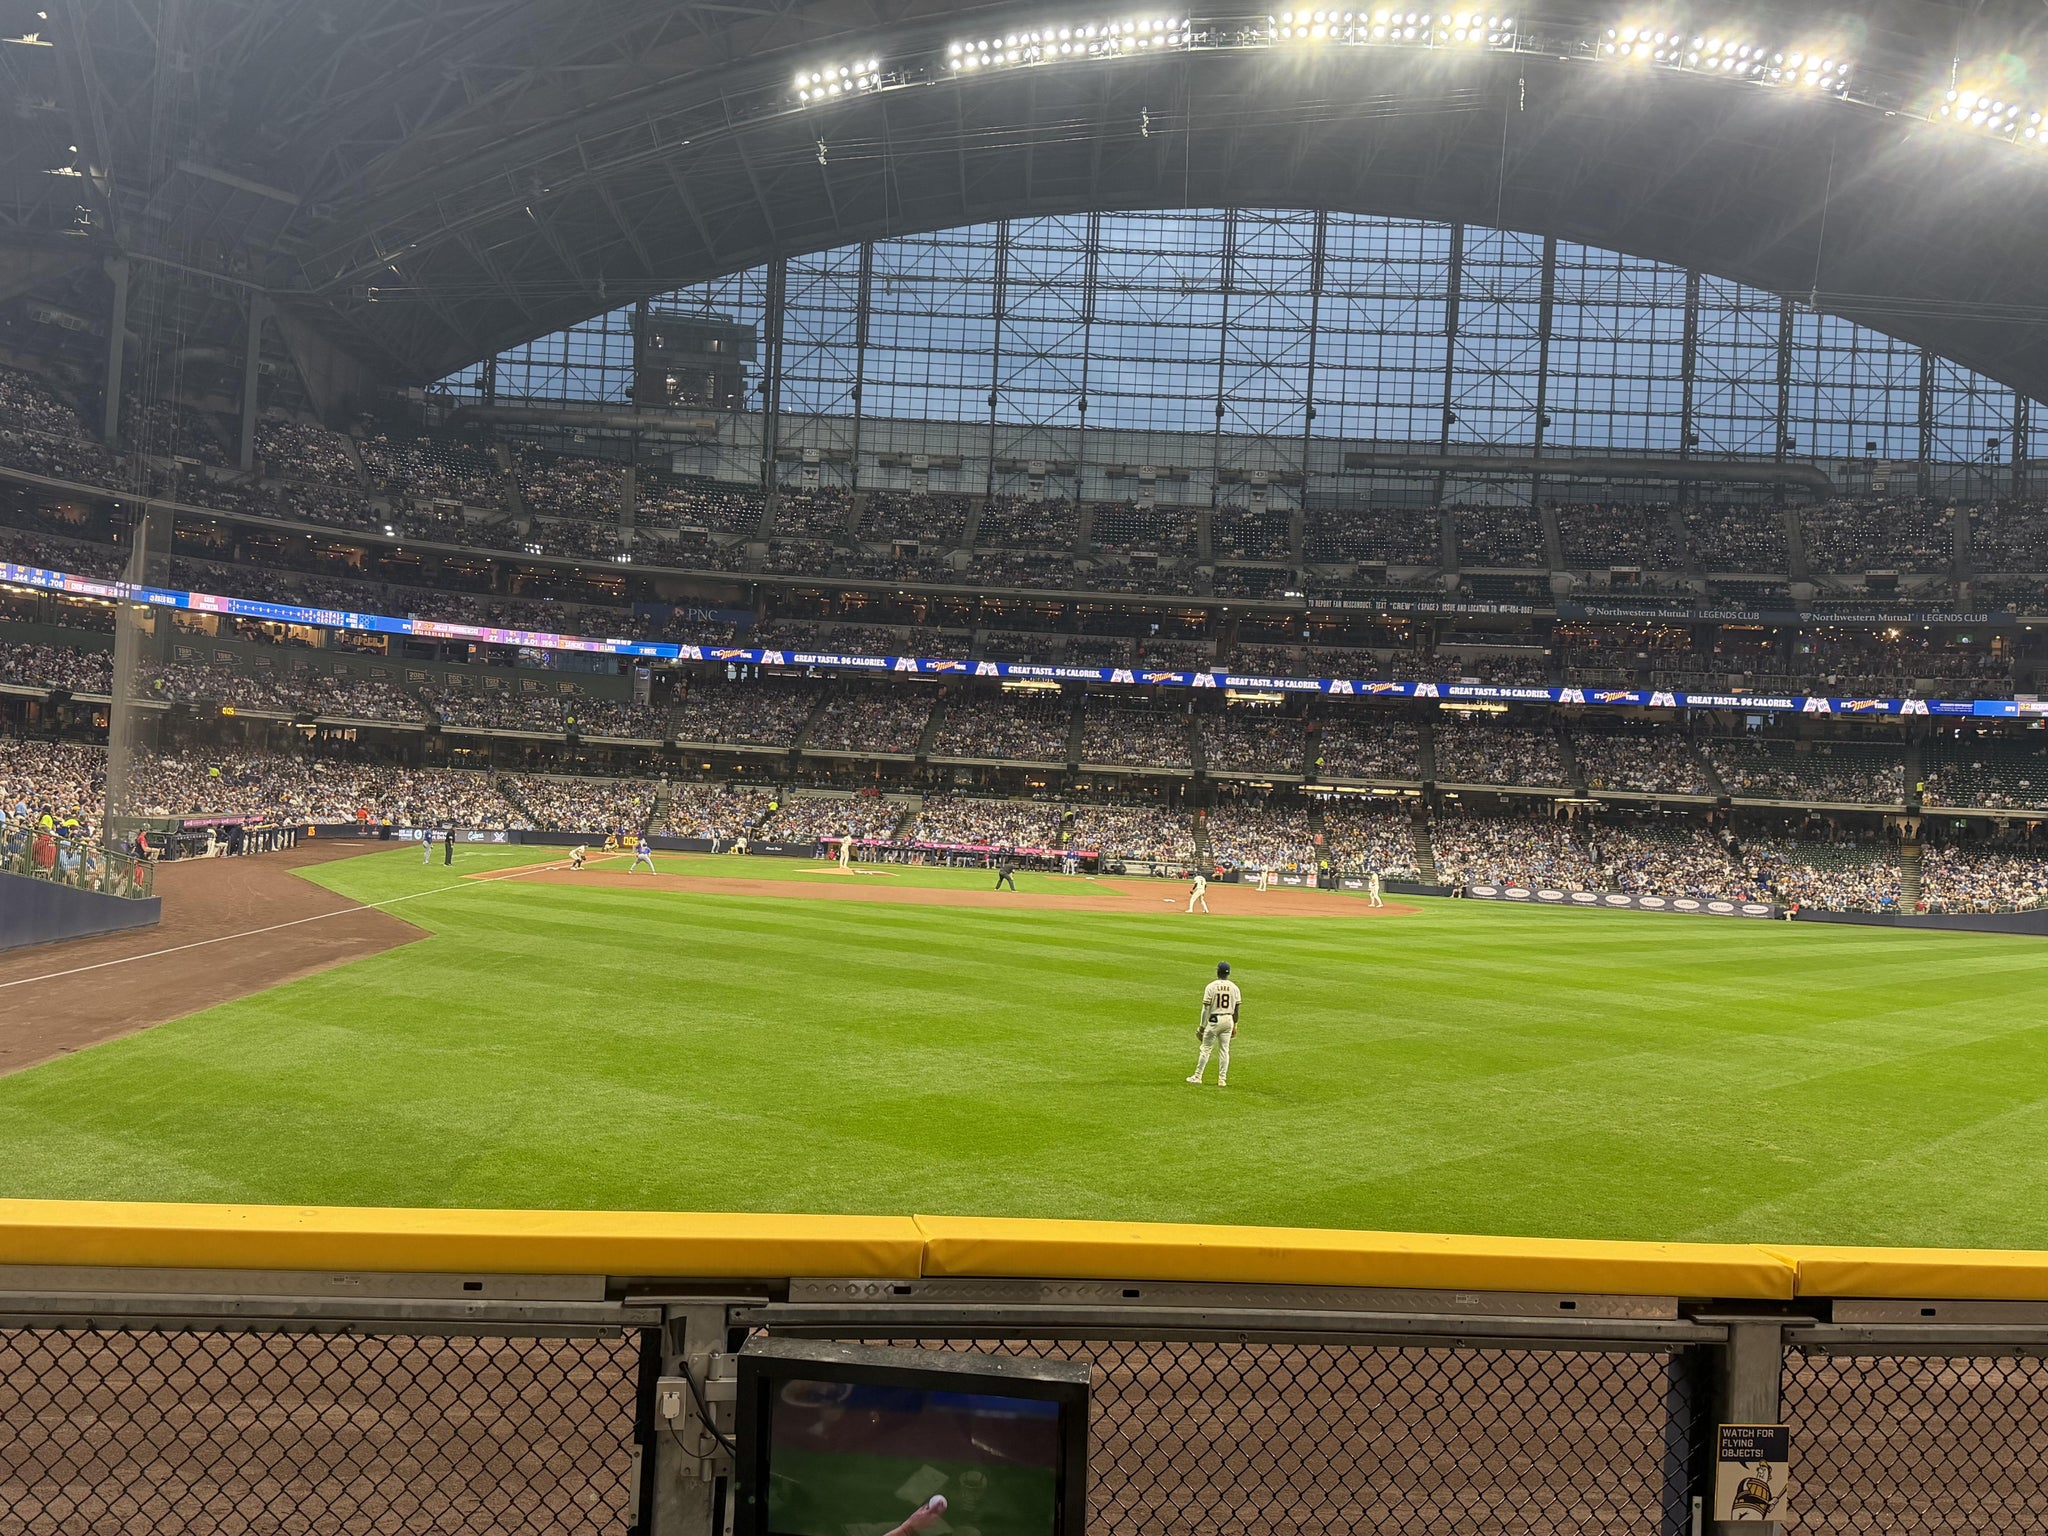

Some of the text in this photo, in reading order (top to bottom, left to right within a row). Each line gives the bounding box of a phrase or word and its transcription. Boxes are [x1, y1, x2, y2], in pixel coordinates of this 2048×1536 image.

[1315, 600, 1332, 608] REPORT
[1333, 600, 1342, 608] FAN
[1442, 604, 1456, 612] ISSUE
[1457, 604, 1466, 612] AND
[1468, 604, 1490, 612] LOCATION
[688, 608, 718, 621] PNC
[1596, 608, 1690, 618] Northwestern Mutual
[1699, 610, 1760, 620] LEGENDS CLUB
[1812, 614, 1912, 622] Northwestern Mutual
[1922, 614, 1988, 622] LEGENDS CLUB
[719, 649, 744, 660] Miller
[794, 654, 816, 663] GREAT
[818, 656, 840, 664] TASTE.
[852, 658, 887, 666] CALORIES.
[934, 661, 958, 672] Miller
[1008, 666, 1102, 678] GREAT TASTE. 96 CALORIES.
[1150, 672, 1176, 682] Miller
[1226, 677, 1322, 690] GREAT TASTE. 96 CALORIES.
[1370, 682, 1396, 693] Miller
[1450, 687, 1551, 698] GREAT TASTE. 96 CALORIES.
[1602, 692, 1630, 702] Miller
[1686, 696, 1794, 708] GREAT TASTE. 96 CALORIES.
[1850, 700, 1880, 712] Miller
[1874, 702, 1889, 710] TIME
[1216, 994, 1230, 1008] 18
[1722, 1429, 1774, 1438] WATCH FOR
[1722, 1439, 1754, 1448] FLYING
[1722, 1449, 1764, 1458] OBJECTS!
